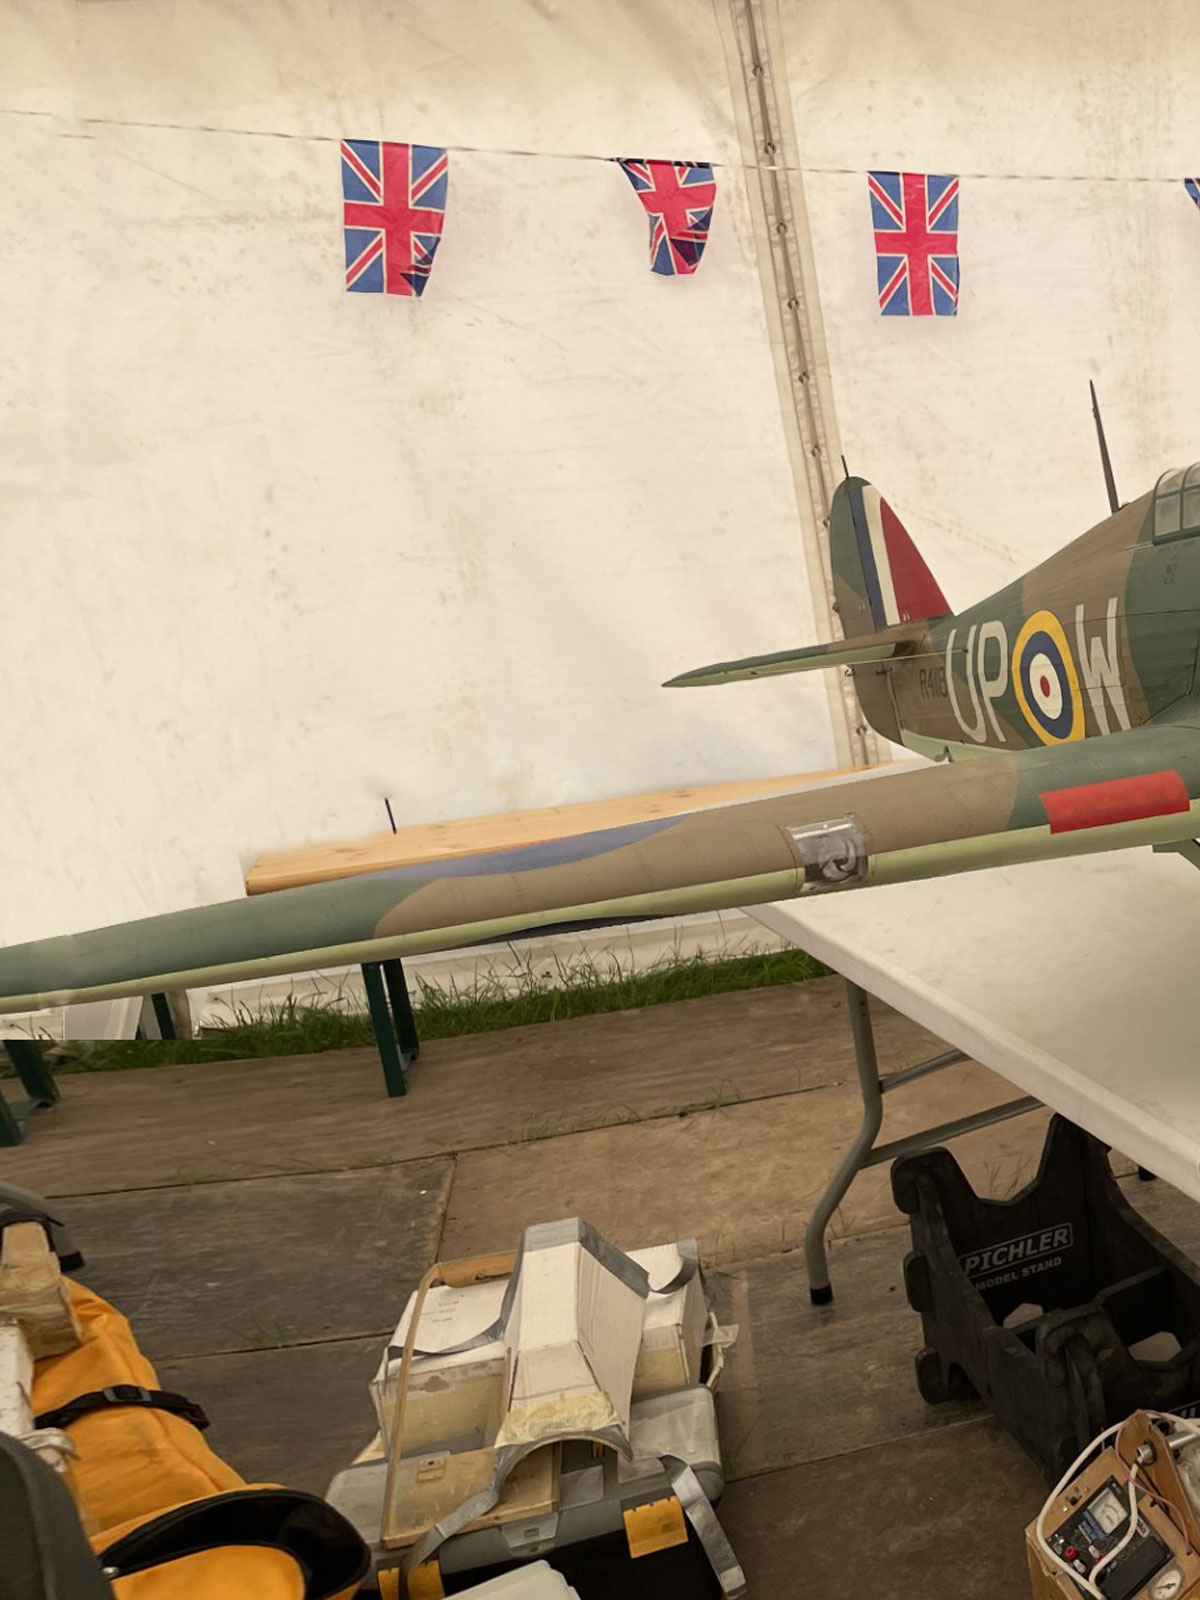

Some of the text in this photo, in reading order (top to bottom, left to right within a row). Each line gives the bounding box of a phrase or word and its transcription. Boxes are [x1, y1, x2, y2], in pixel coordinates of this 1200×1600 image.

[945, 597, 1131, 743] UP W
[965, 1227, 1069, 1274] PICHLER
[975, 1256, 1062, 1291] MODEL STAND
